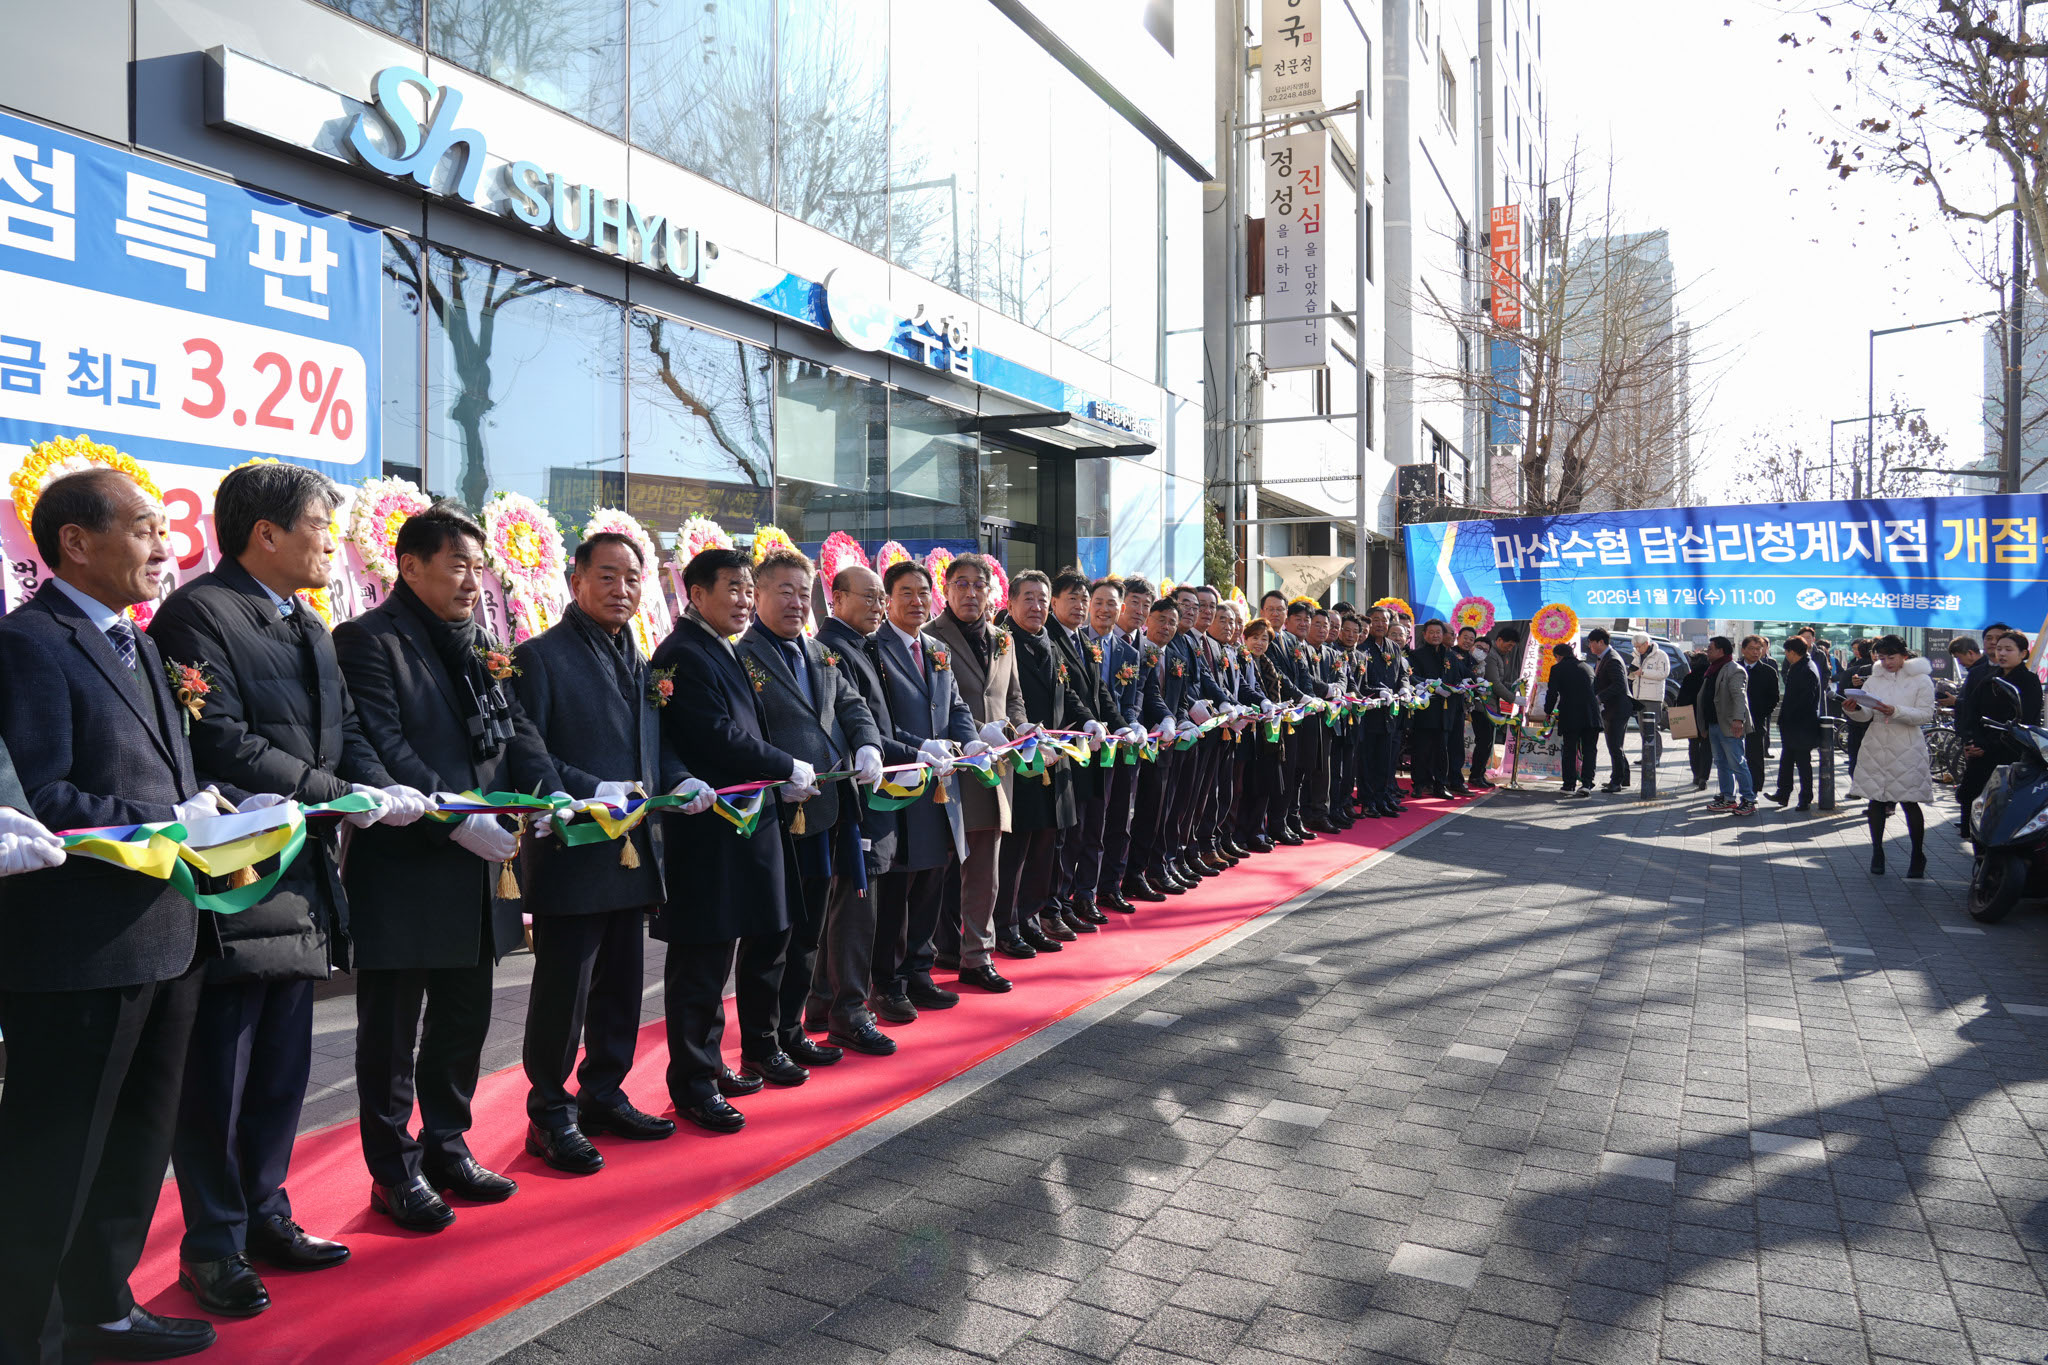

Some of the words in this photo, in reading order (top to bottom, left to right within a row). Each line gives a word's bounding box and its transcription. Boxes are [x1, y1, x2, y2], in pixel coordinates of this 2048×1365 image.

[1278, 0, 1305, 48] 국
[1273, 55, 1312, 77] 전문점
[1268, 88, 1317, 102] 02.2248.4889
[349, 65, 487, 203] Sh
[508, 159, 719, 284] SUHYUP
[1270, 147, 1293, 239] 정성을
[1297, 165, 1321, 257] 진심을
[1492, 206, 1518, 224] 미래
[1276, 245, 1290, 294] 다하고
[1494, 224, 1519, 317] 고시원
[1304, 263, 1318, 347] 담았습니다
[907, 303, 974, 381] 수협
[67, 347, 161, 410] 최고
[181, 338, 353, 441] 3.2%
[1491, 528, 1632, 569] 마산수협
[1639, 518, 1929, 564] 답십리청계지점
[1942, 517, 2048, 564] 개점
[1587, 589, 1641, 605] 2026년
[1644, 589, 1668, 605] 1월
[1675, 588, 1726, 606] 7일(수)
[1729, 588, 1776, 605] 11:00
[1829, 591, 1961, 611] 마산수산업협동조합
